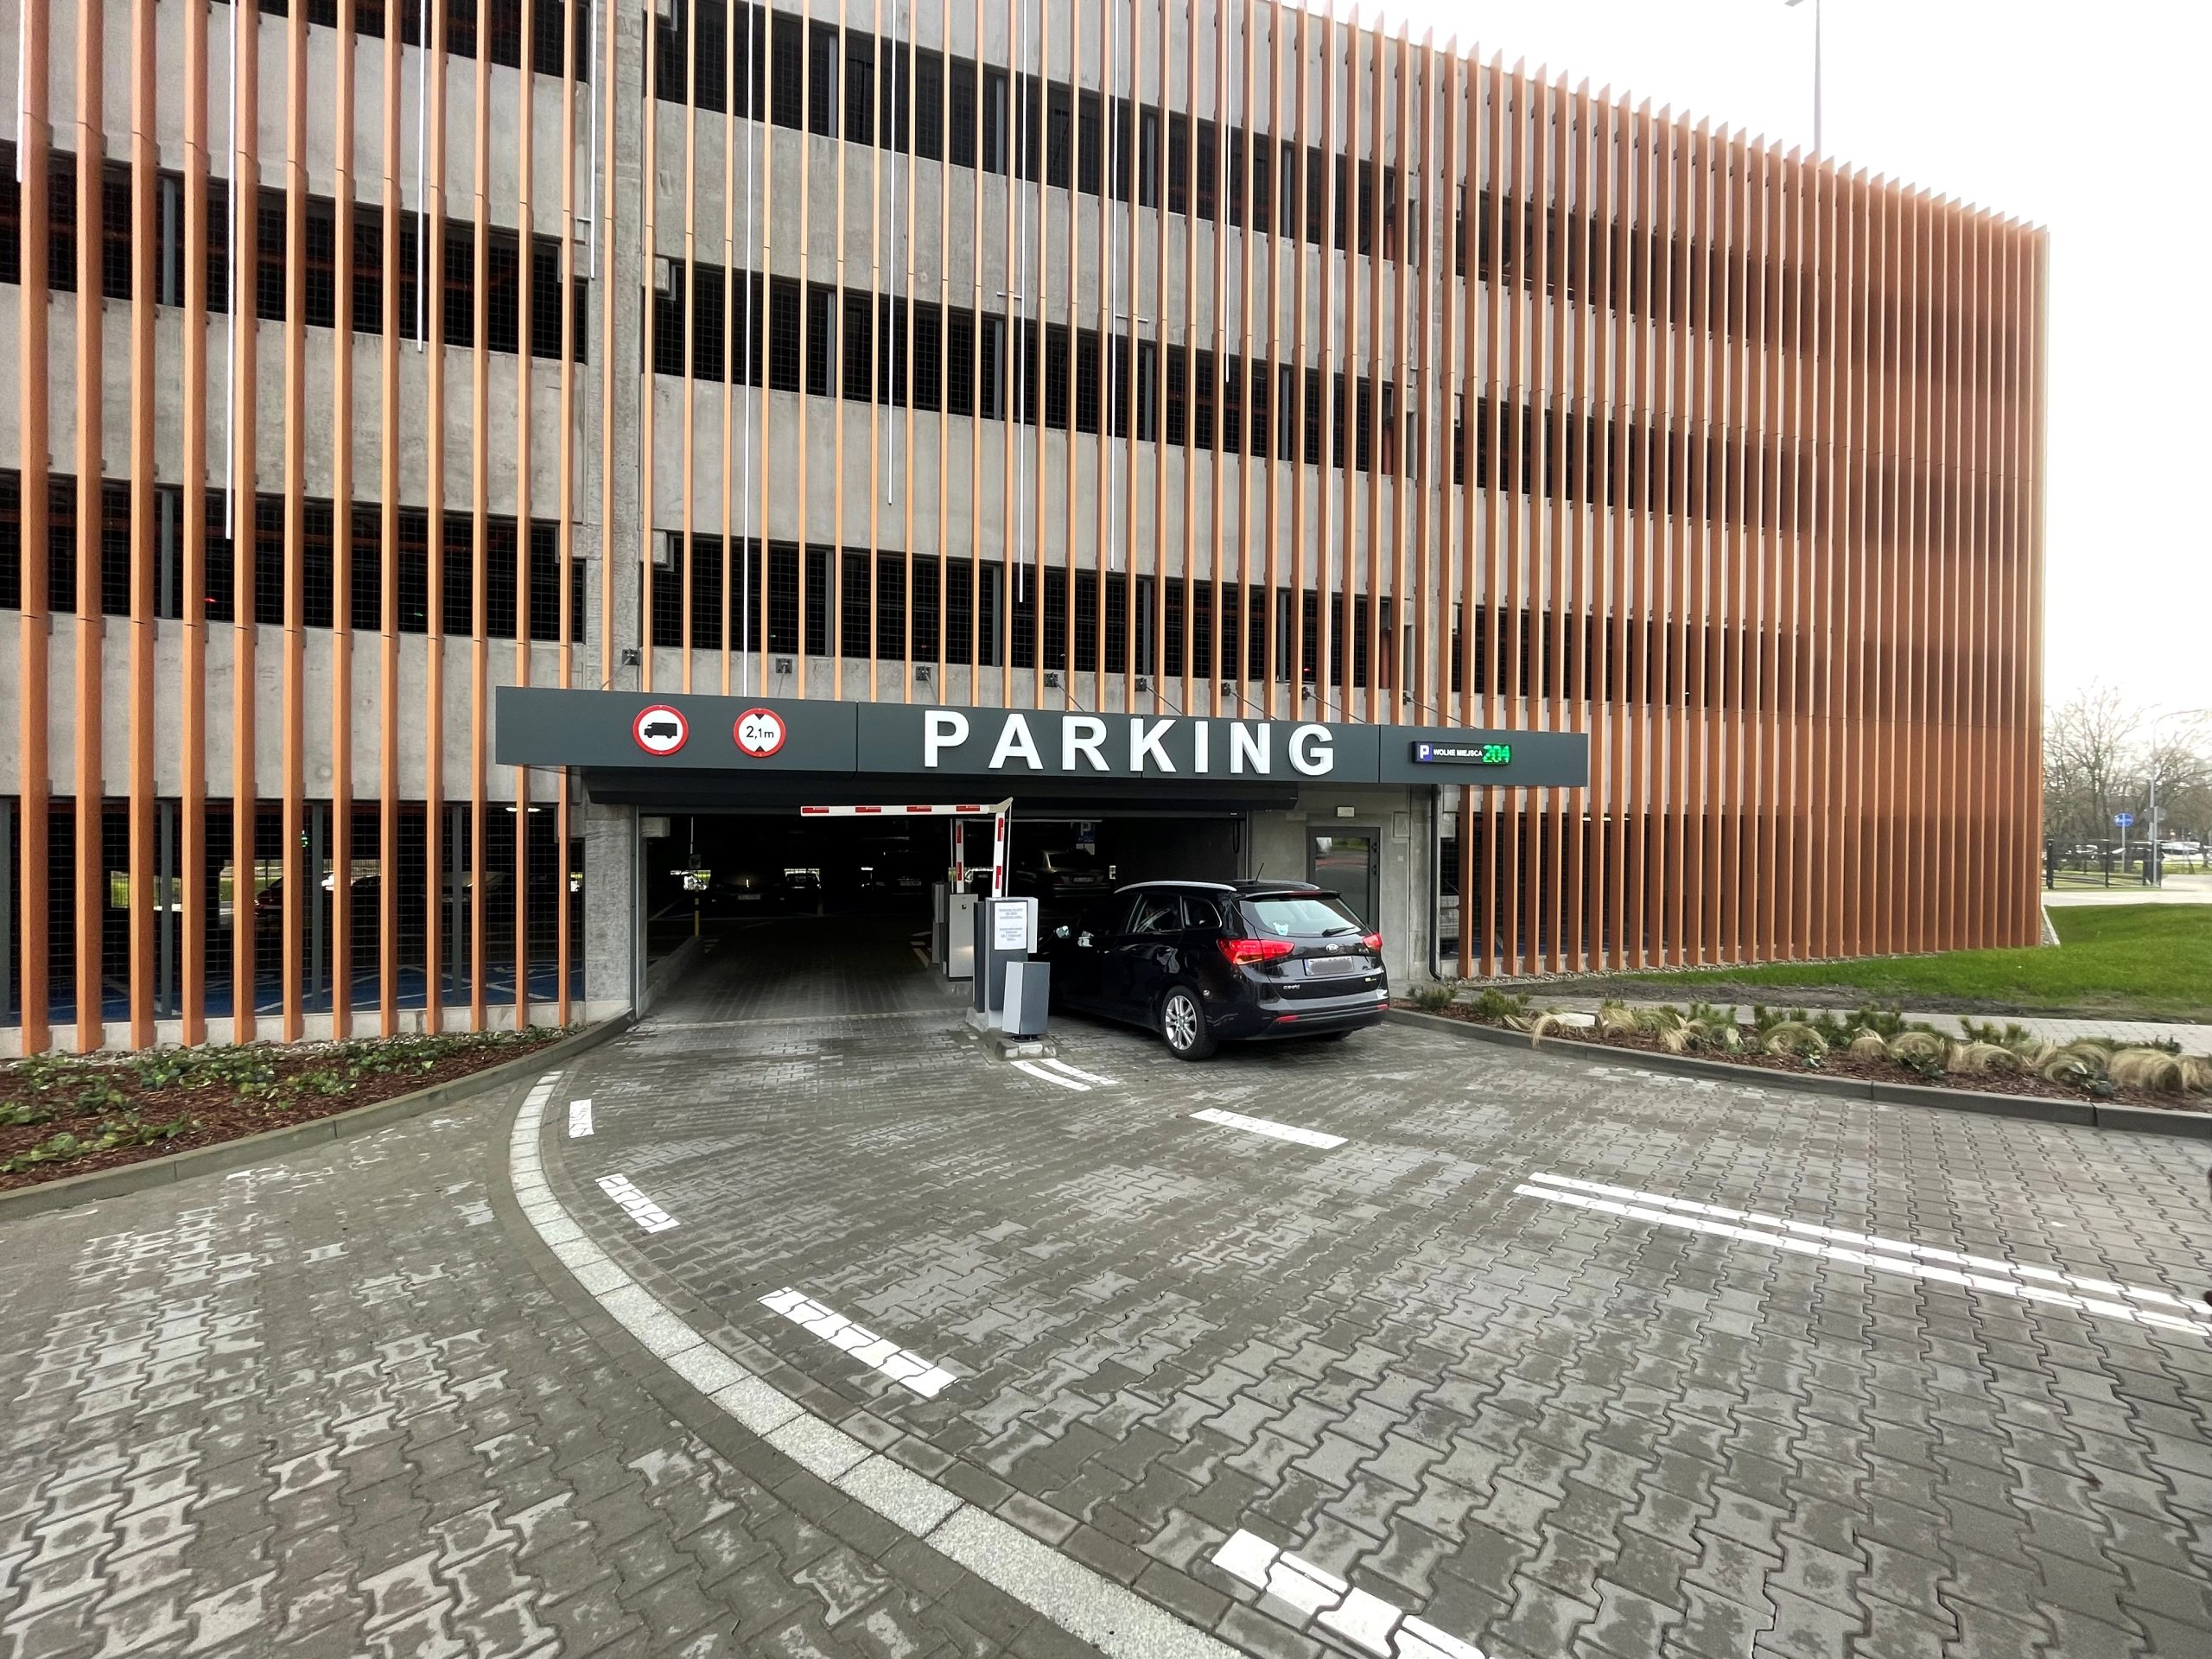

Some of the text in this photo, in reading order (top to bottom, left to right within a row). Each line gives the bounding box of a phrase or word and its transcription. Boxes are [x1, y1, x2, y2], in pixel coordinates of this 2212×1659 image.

[746, 725, 774, 740] 2,1m
[924, 709, 1334, 776] PARKING
[1420, 744, 1429, 760] P
[1433, 748, 1456, 757] WOLNE
[1483, 744, 1510, 763] 204
